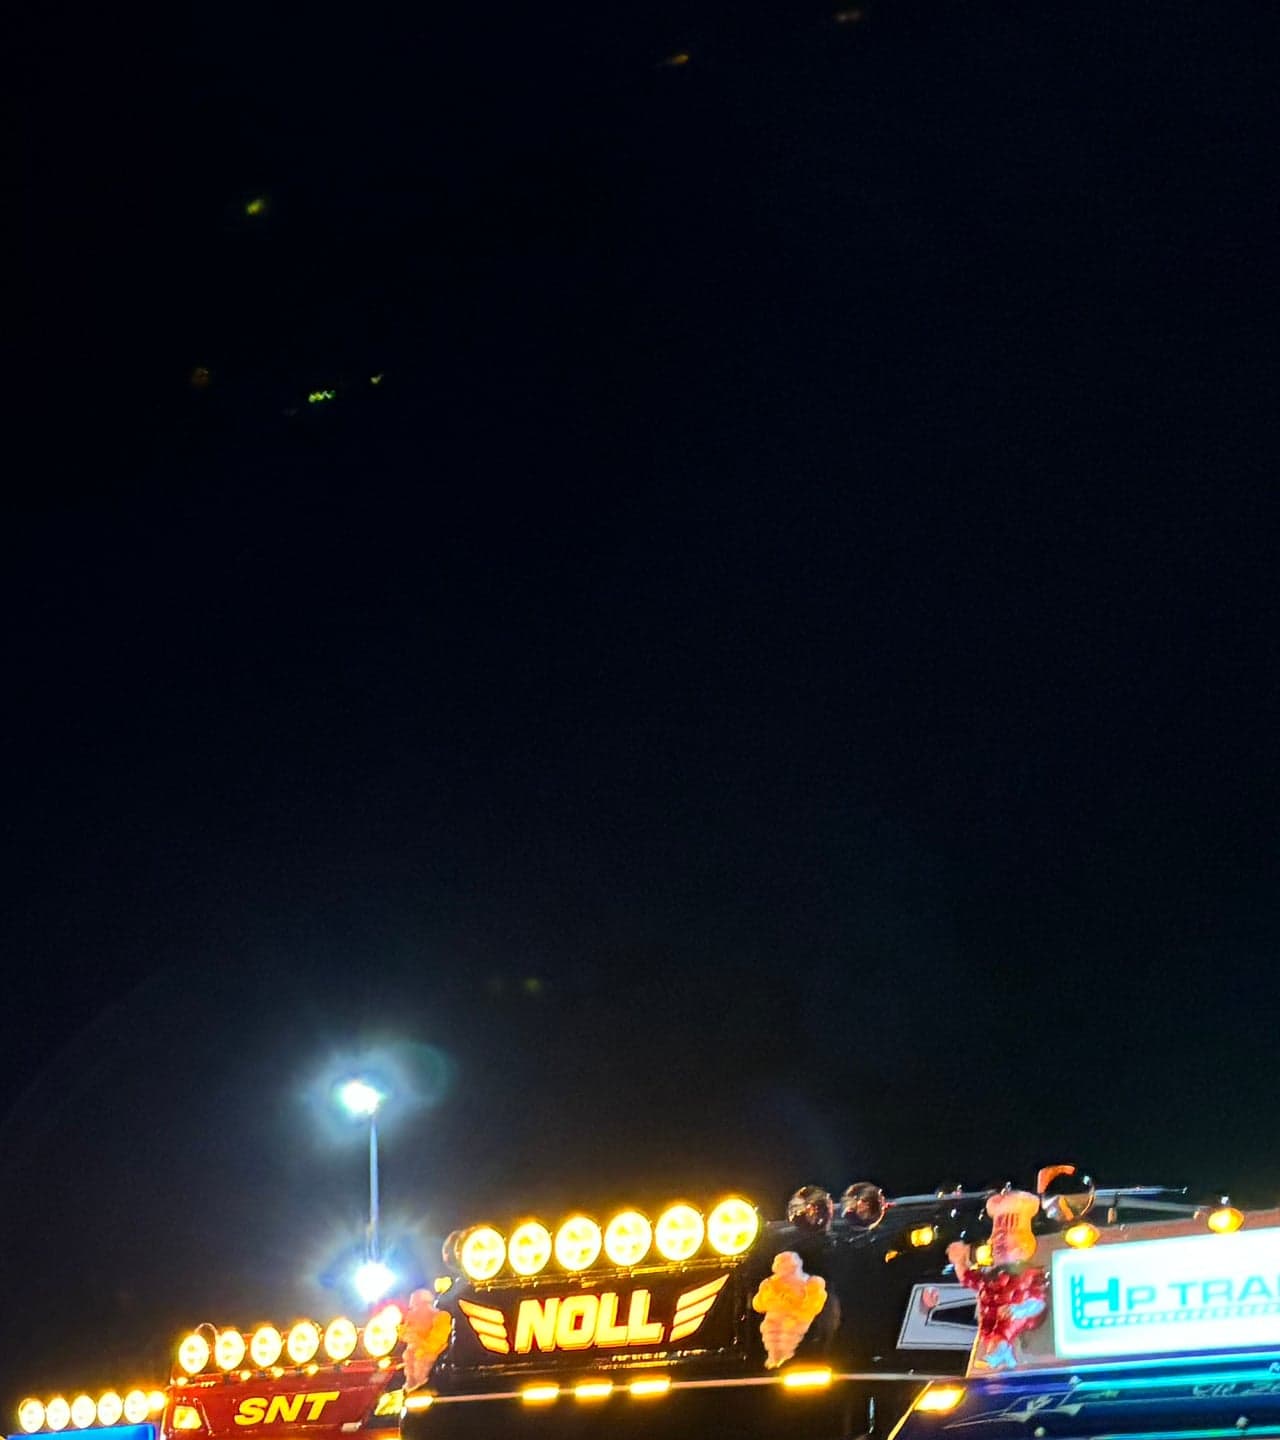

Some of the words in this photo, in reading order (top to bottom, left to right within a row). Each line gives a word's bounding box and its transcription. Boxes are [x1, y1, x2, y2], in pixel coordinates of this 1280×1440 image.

[1167, 1274, 1280, 1308] TRA
[514, 1289, 664, 1354] NOLL
[234, 1391, 340, 1426] SNT
